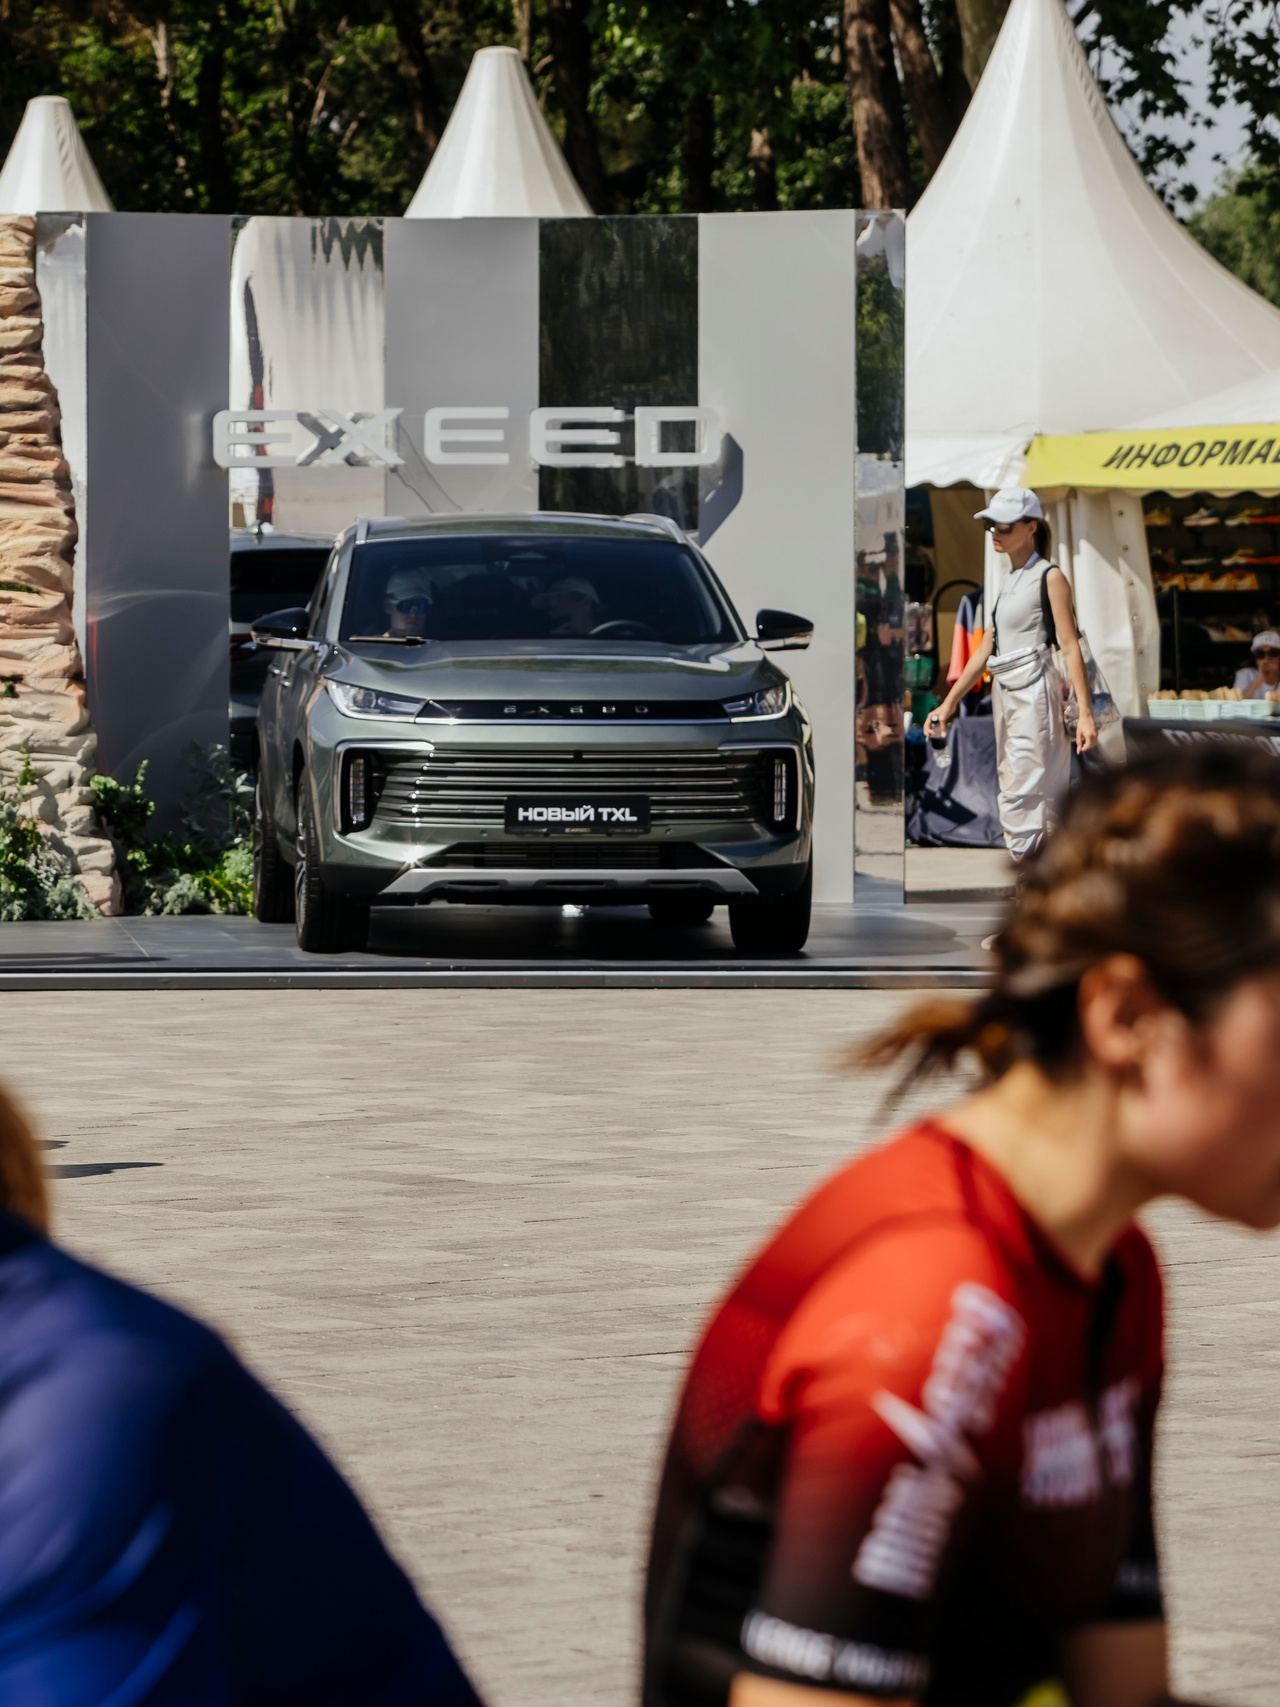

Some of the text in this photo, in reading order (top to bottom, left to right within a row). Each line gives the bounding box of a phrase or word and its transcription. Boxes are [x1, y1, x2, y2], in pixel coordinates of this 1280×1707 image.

[213, 406, 721, 467] EXEED
[518, 805, 638, 821] НОВЫЙ TXL
